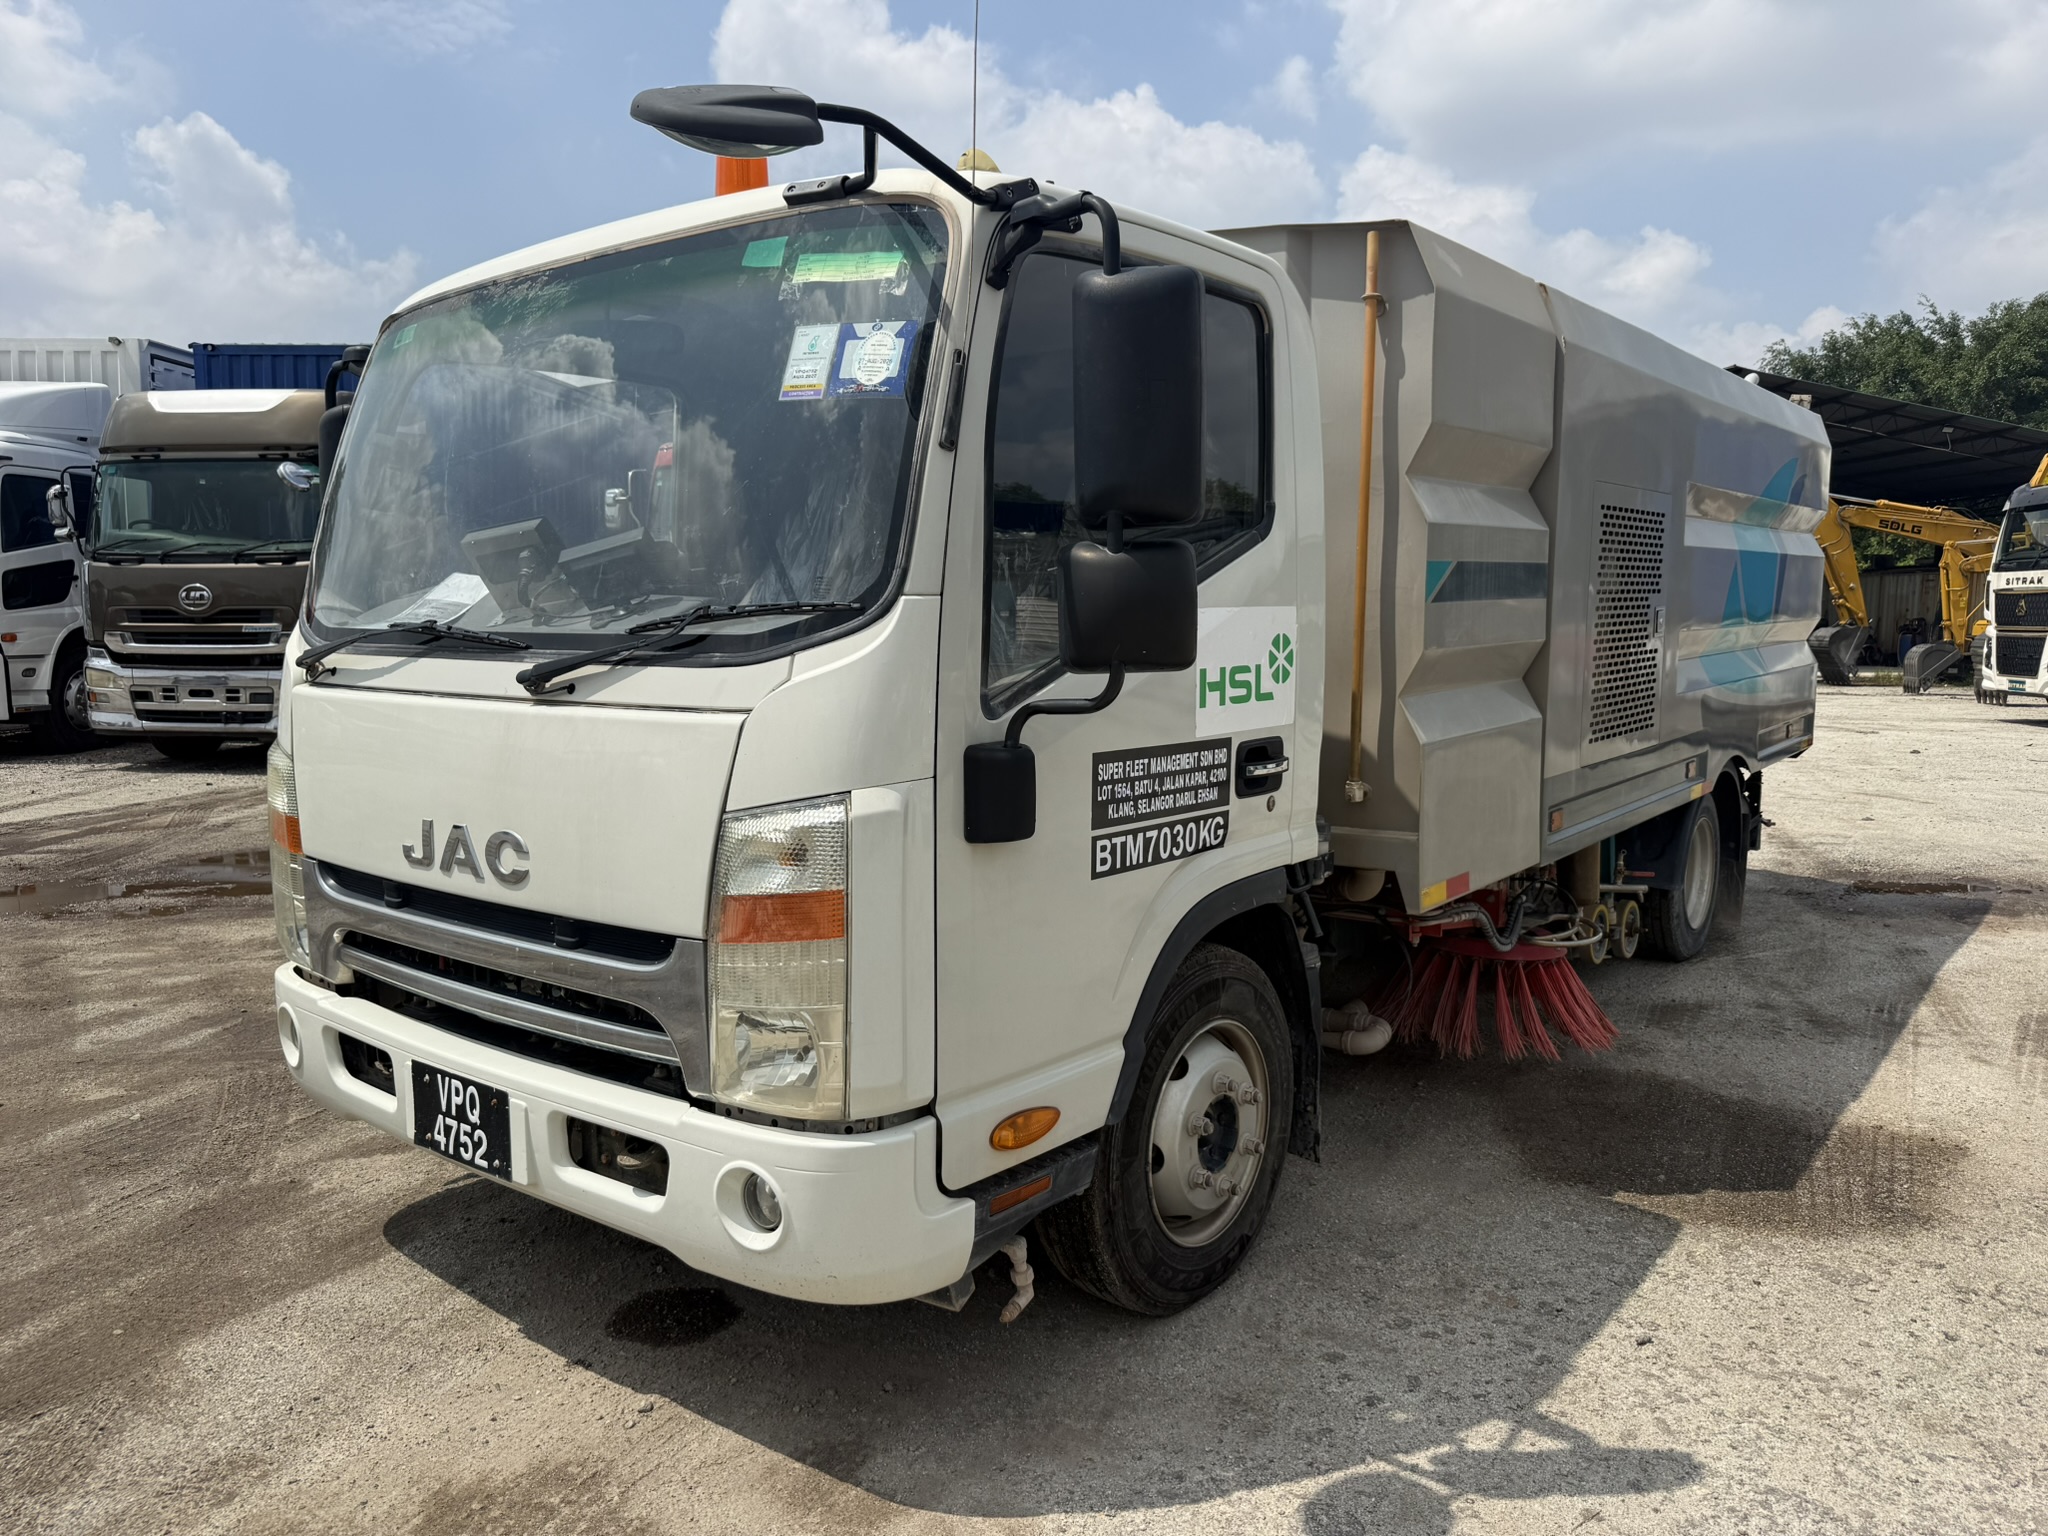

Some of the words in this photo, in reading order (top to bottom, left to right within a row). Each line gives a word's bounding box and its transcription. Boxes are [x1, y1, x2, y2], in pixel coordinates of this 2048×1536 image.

[1878, 518, 1923, 535] SDLG
[2005, 576, 2044, 586] SITRAK
[1199, 664, 1274, 709] HSL
[1098, 761, 1124, 781] SUPER
[1125, 758, 1149, 778] FLEET
[1150, 752, 1199, 774] MANAGEMENT
[1200, 749, 1213, 767] SDN
[1214, 748, 1228, 765] BHD
[1097, 784, 1112, 801] LOT
[1114, 782, 1133, 800] 1564,
[1134, 779, 1153, 796] BATU
[1154, 778, 1161, 795] 4,
[1162, 774, 1184, 791] JALAN
[1185, 770, 1209, 787] KAPAR,
[1209, 767, 1227, 783] 42100
[1108, 801, 1136, 819] KLANG,
[1137, 794, 1174, 814] SELANGOR
[1175, 790, 1196, 807] DARUL
[1197, 786, 1219, 803] EHSAN
[401, 818, 531, 886] JAC
[436, 1073, 481, 1127] VPQ
[433, 1113, 489, 1169] 4752
